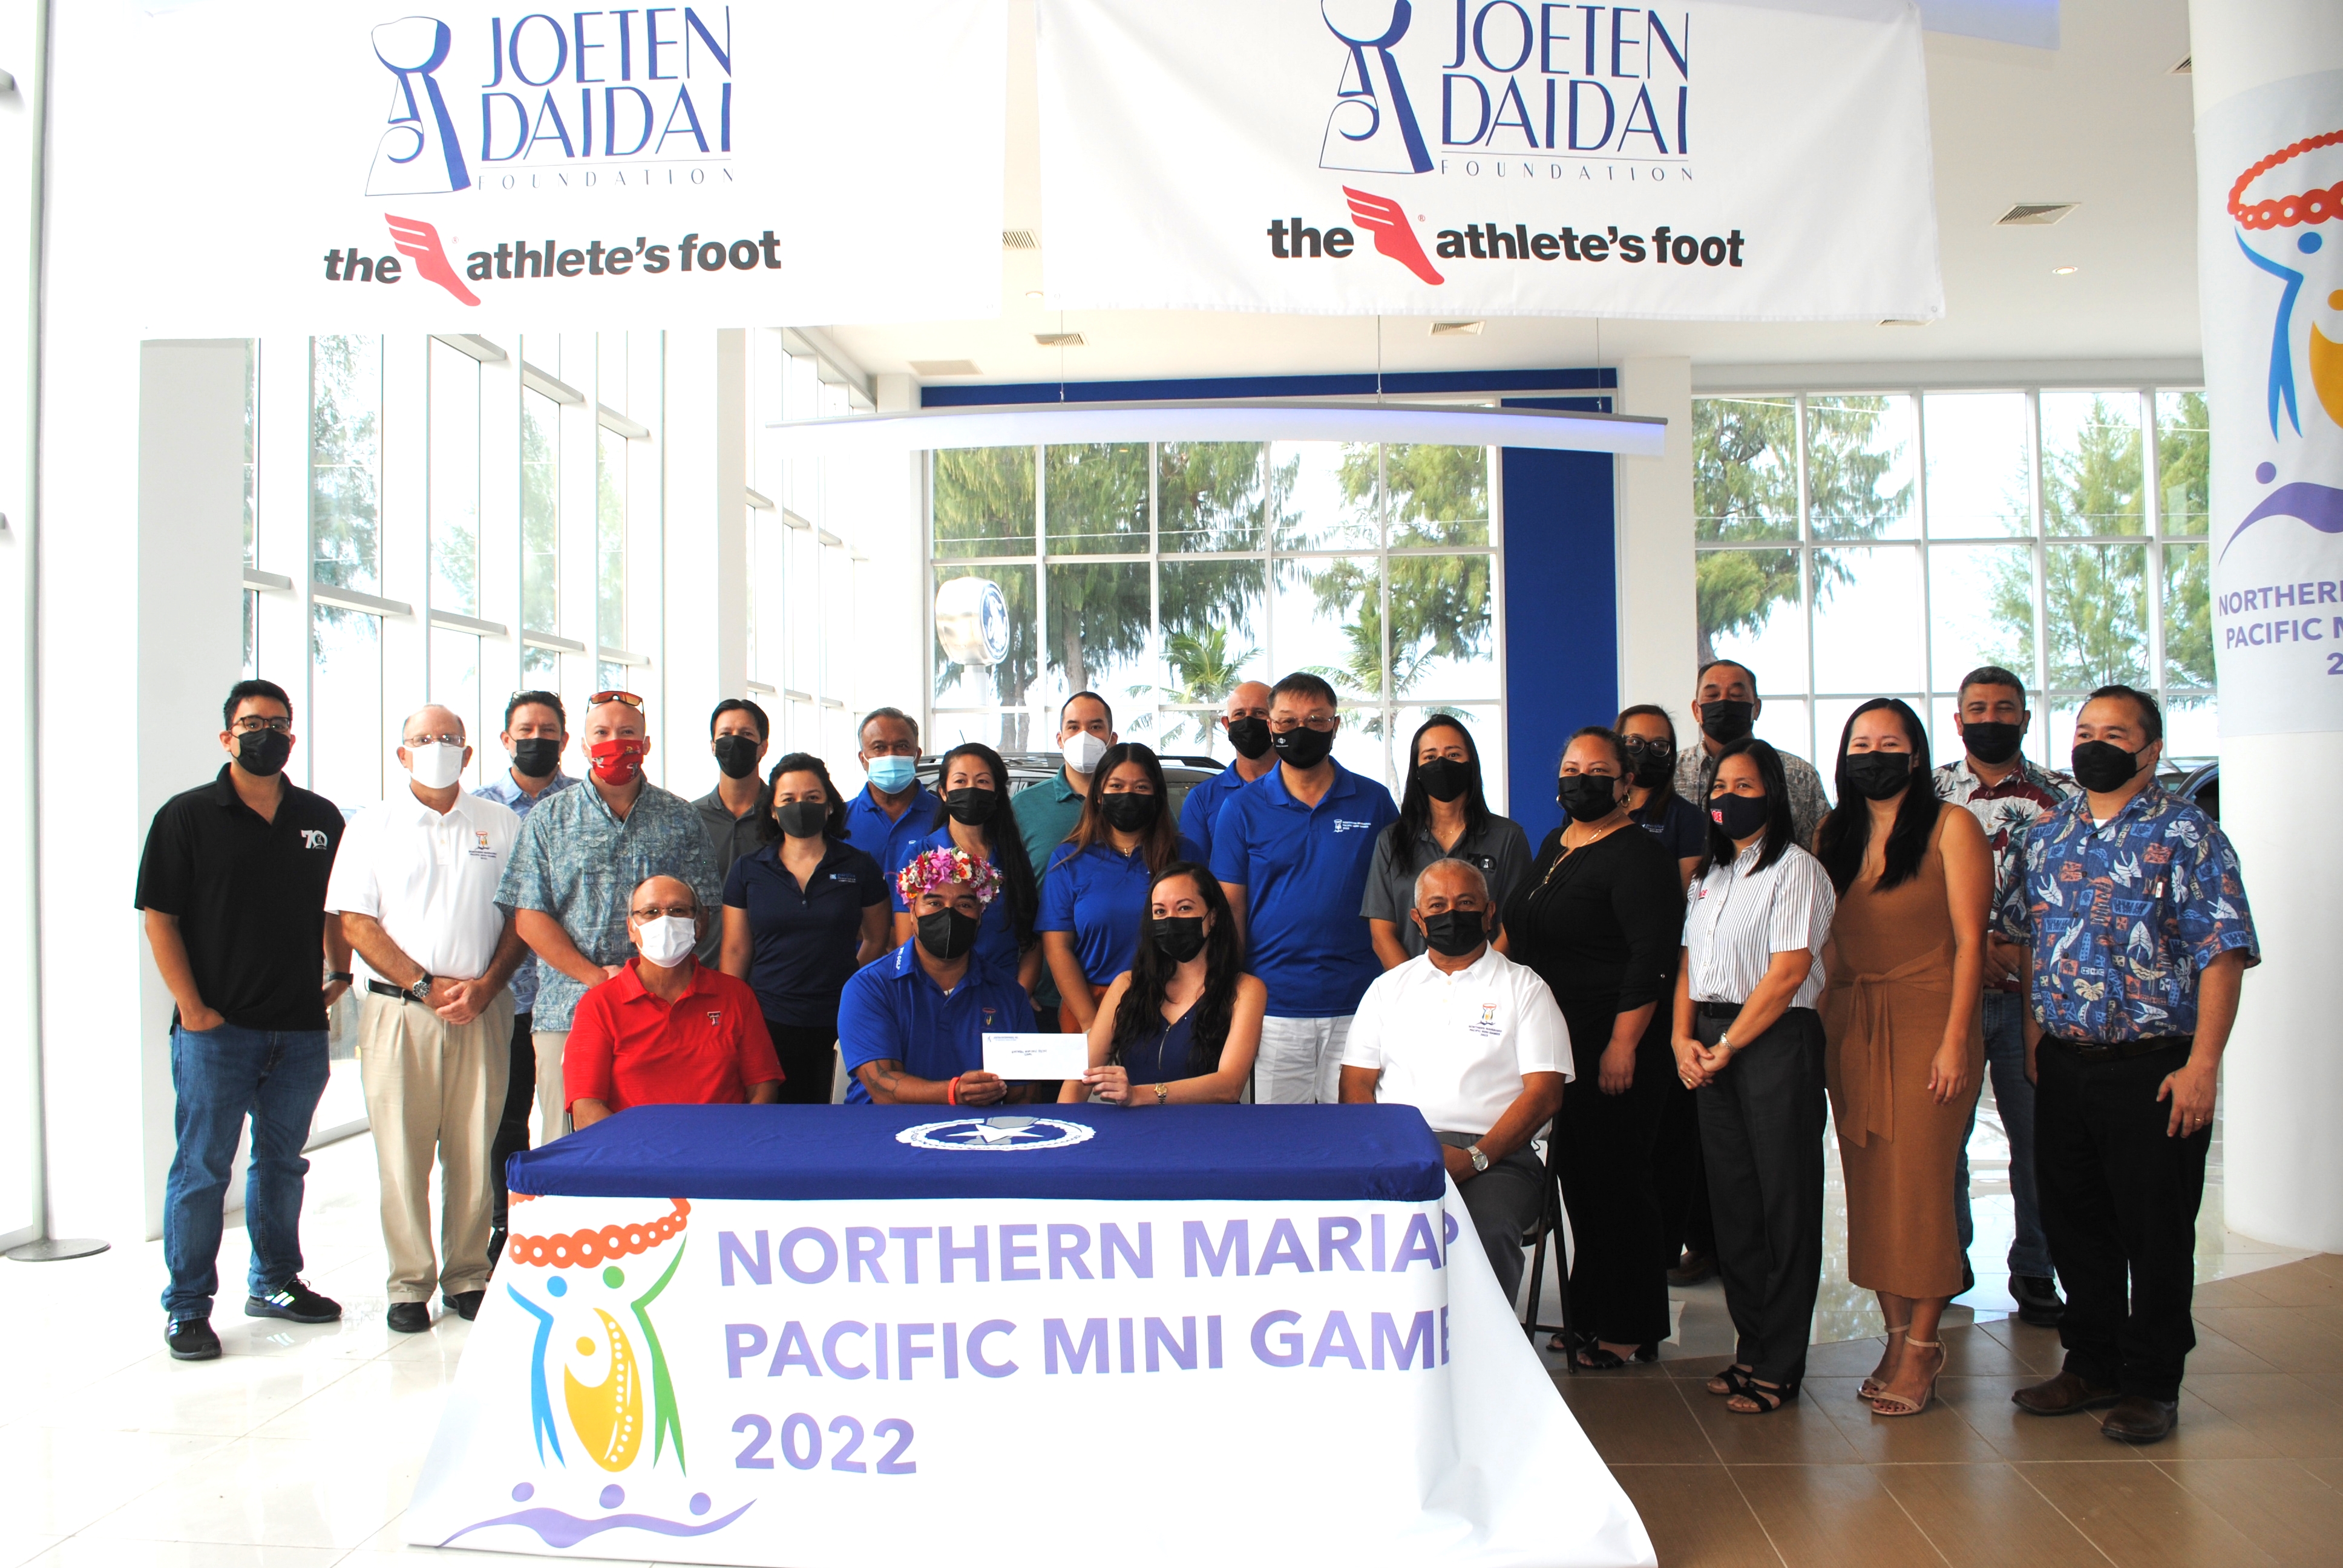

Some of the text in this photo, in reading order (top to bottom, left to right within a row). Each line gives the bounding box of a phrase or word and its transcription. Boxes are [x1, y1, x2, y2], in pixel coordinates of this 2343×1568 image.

[482, 5, 732, 88] JOETEN
[1443, 0, 1688, 82] JOETEN
[481, 82, 732, 161] DAIDAI
[1443, 73, 1688, 153] DAIDAI
[478, 168, 734, 191] FOUNDATION
[1441, 159, 1693, 181] FOUNDATION
[324, 230, 782, 284] the athlete's foot
[1267, 218, 1745, 267] the athlete's foot
[2219, 580, 2343, 616] NORTHER
[2226, 618, 2323, 649] PACIFIC
[301, 829, 328, 849] 70
[719, 1222, 1155, 1285] NORTHERN
[726, 1319, 1019, 1379] PACIFIC
[1044, 1315, 1222, 1373] MINI
[730, 1413, 916, 1473] 2022
